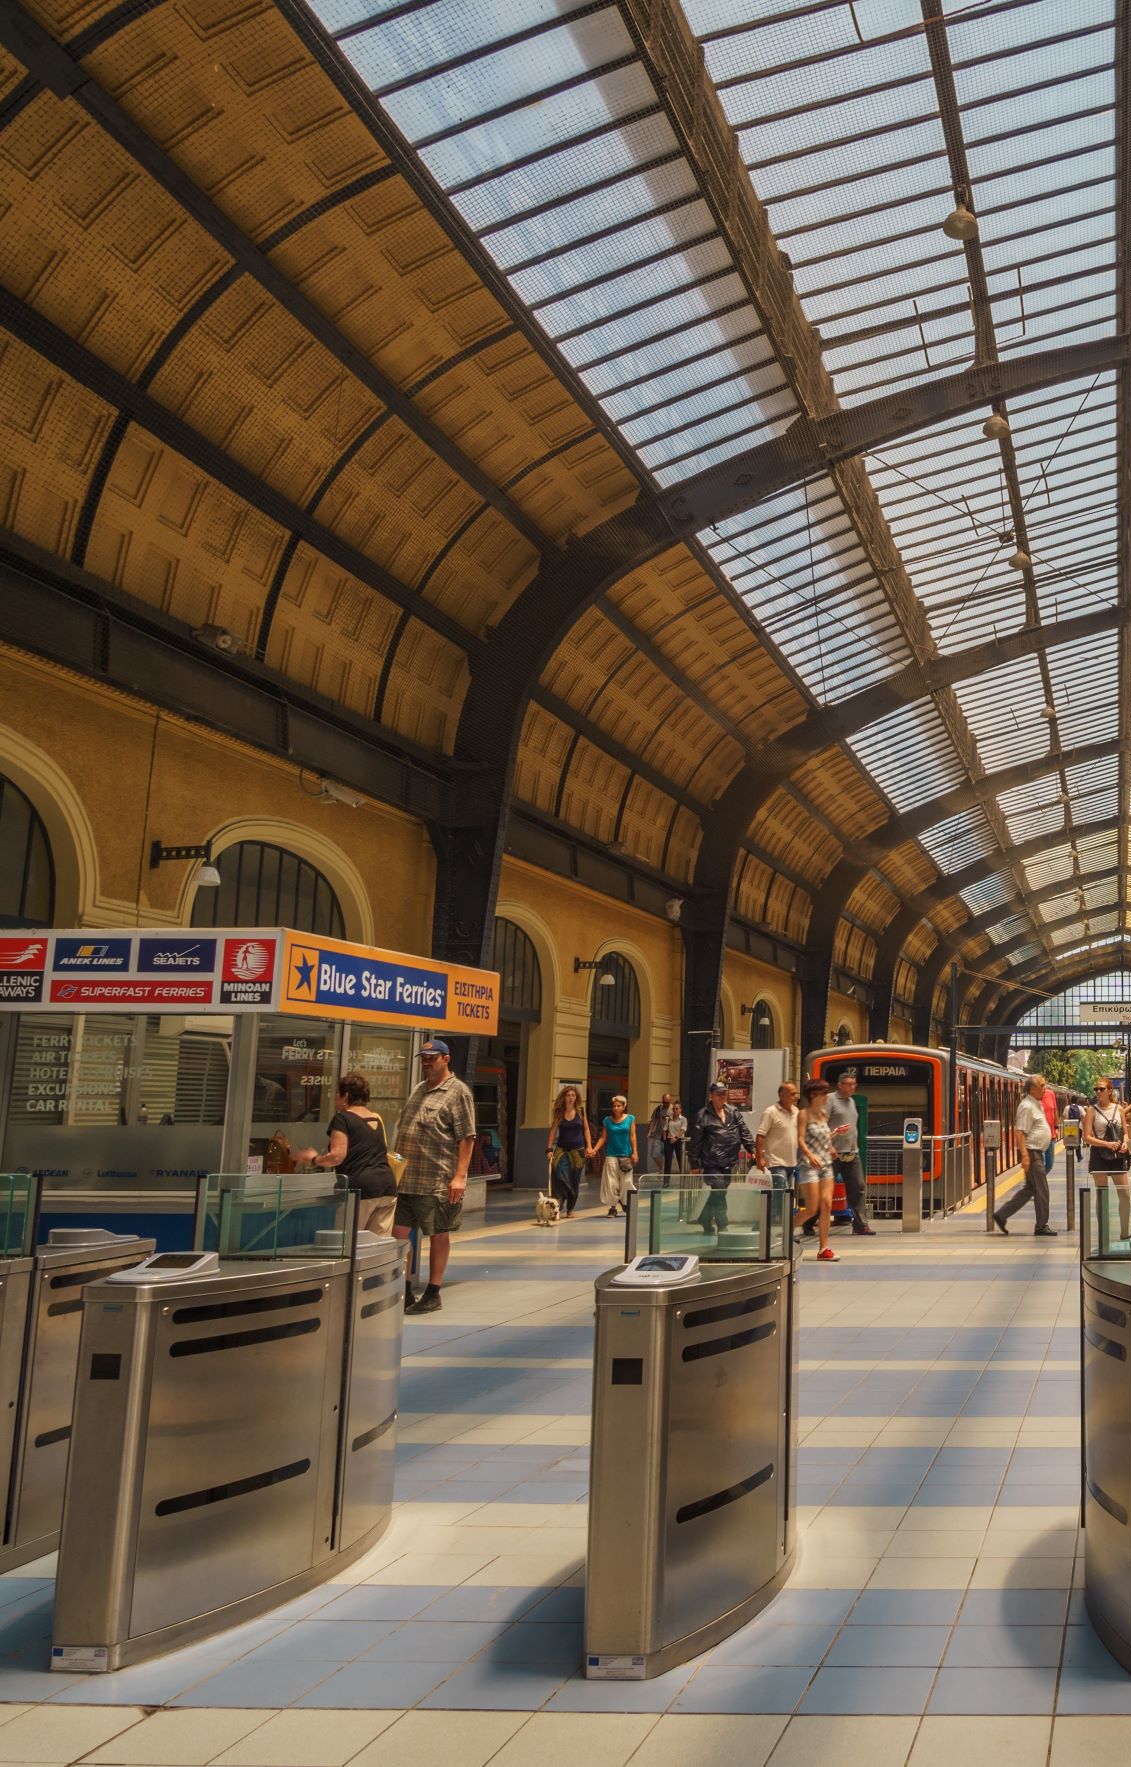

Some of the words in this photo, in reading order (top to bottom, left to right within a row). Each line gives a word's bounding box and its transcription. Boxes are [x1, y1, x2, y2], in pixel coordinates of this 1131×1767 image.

[59, 957, 93, 965] ANEK
[93, 957, 124, 965] LINES
[153, 957, 200, 965] SEAJETS
[223, 982, 270, 992] MINOAN
[319, 963, 357, 996] Blue
[361, 970, 393, 1001] Star
[395, 976, 443, 1008] Ferries
[454, 980, 494, 1001] ΕΙΣΙΤΗΡΙΑ
[80, 986, 151, 997] SUPERFAST
[154, 987, 205, 997] FERRIES
[231, 992, 261, 1002] LINES
[456, 1001, 491, 1020] TICKETS
[32, 1051, 56, 1063] AIR
[865, 1067, 906, 1076] ΠΕΙΡΑΙΑ
[26, 1099, 55, 1112] CAR
